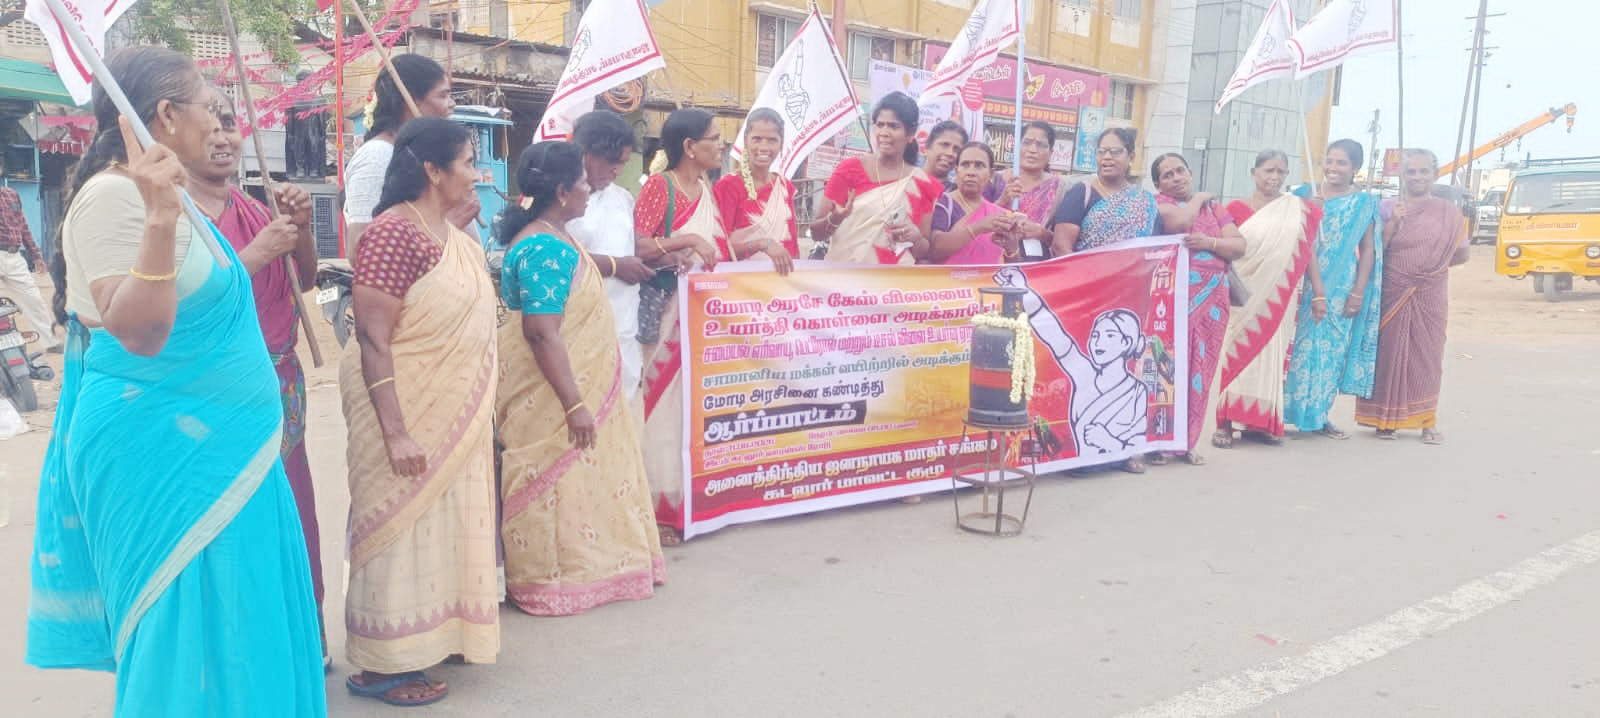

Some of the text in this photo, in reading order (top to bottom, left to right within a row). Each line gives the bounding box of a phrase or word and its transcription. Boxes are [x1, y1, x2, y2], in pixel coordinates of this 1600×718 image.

[705, 288, 974, 317] மோடி அரசே கேஸ் விலையை
[705, 316, 790, 337] உயர்த்தி
[793, 311, 888, 331] கொள்ளை
[1153, 320, 1168, 331] GAS
[704, 368, 786, 388] சாமானிய
[790, 362, 837, 381] மக்கள்
[839, 355, 909, 375] வயிற்றில்
[704, 377, 884, 410] மோடி அரசினை கண்டித்து
[704, 403, 857, 441] ஆர்ப்பாட்டம்
[704, 460, 824, 496] அனைத்திந்திய
[825, 451, 903, 477] ஜனநாயக
[904, 440, 948, 463] மாதர்
[763, 464, 945, 500] கடலூர் மாவட்ட குழு
